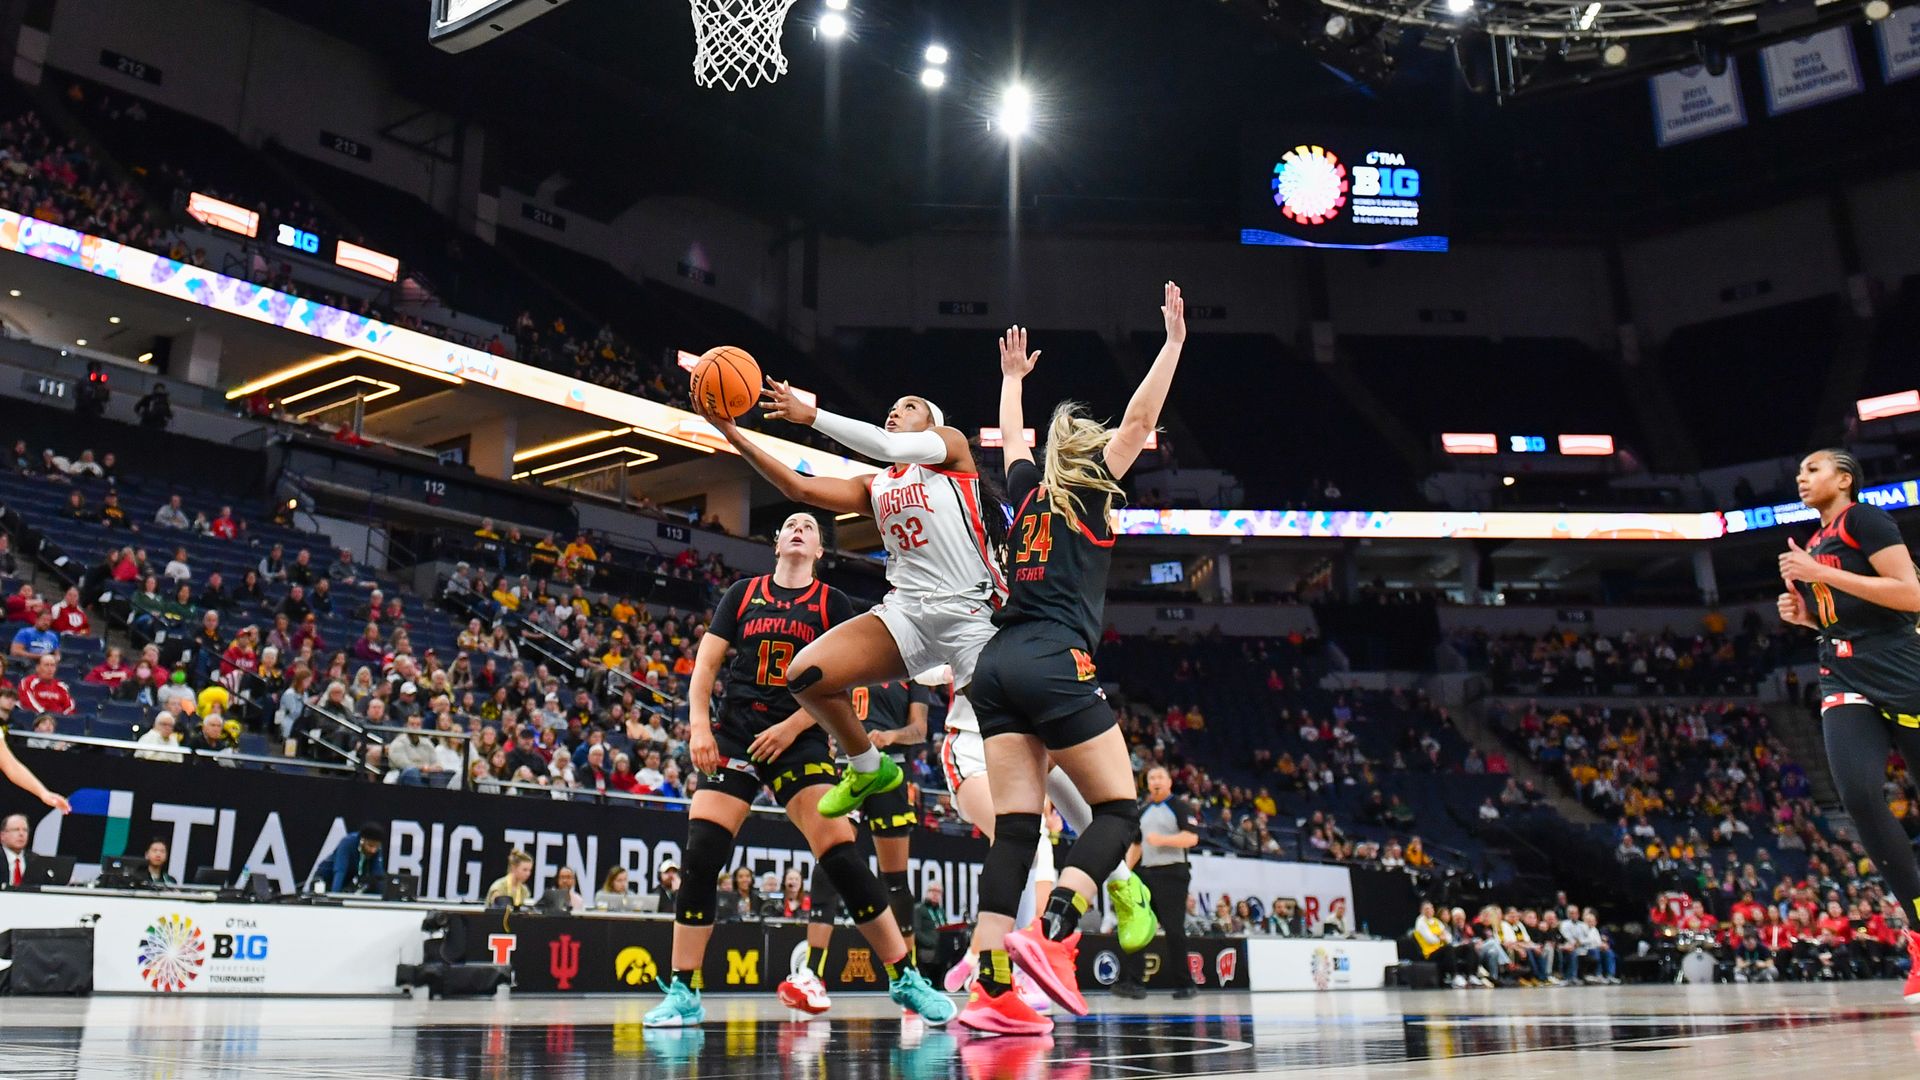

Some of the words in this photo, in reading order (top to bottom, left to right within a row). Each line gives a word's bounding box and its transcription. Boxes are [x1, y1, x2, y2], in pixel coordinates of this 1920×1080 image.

[1778, 69, 1847, 98] CHAMPIONS
[1667, 104, 1734, 130] CHAMPIONS
[1379, 152, 1405, 166] TIAA
[38, 378, 65, 398] 111
[423, 479, 446, 496] 112
[1864, 487, 1906, 507] TIAA
[665, 527, 684, 541] 113
[890, 516, 929, 552] 32
[1016, 512, 1053, 563] 34
[743, 618, 816, 644] MARYLAND
[756, 639, 794, 687] 13
[386, 820, 483, 904] BIG
[209, 975, 265, 984] TOURNAMENT
[726, 950, 759, 984] M
